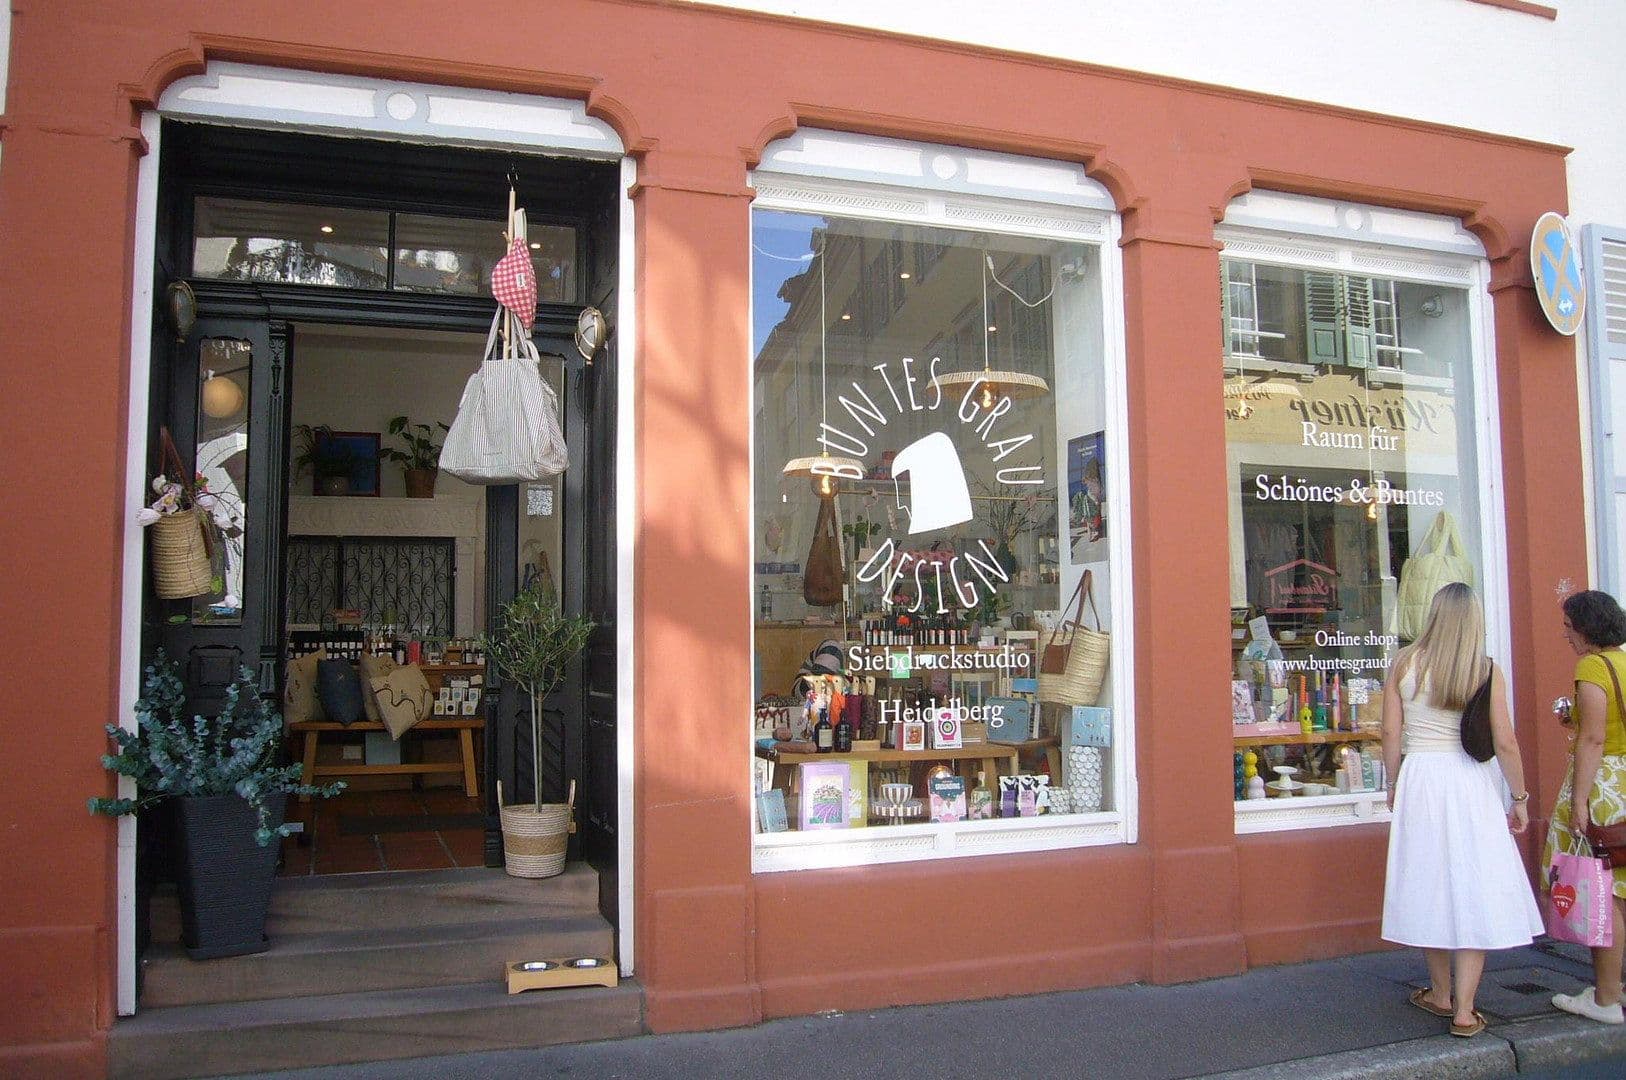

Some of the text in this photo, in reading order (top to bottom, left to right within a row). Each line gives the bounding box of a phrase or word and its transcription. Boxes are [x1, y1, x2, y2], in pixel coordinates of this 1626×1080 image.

[810, 357, 1044, 484] BUNTES GRAU
[1301, 421, 1398, 451] Raum für
[1256, 474, 1444, 506] Schönes & Buntes
[856, 537, 1009, 614] DESIGN
[1315, 630, 1399, 650] Online shop:
[848, 645, 1030, 672] Siebdruckstudio
[878, 699, 1004, 727] Heidelberg
